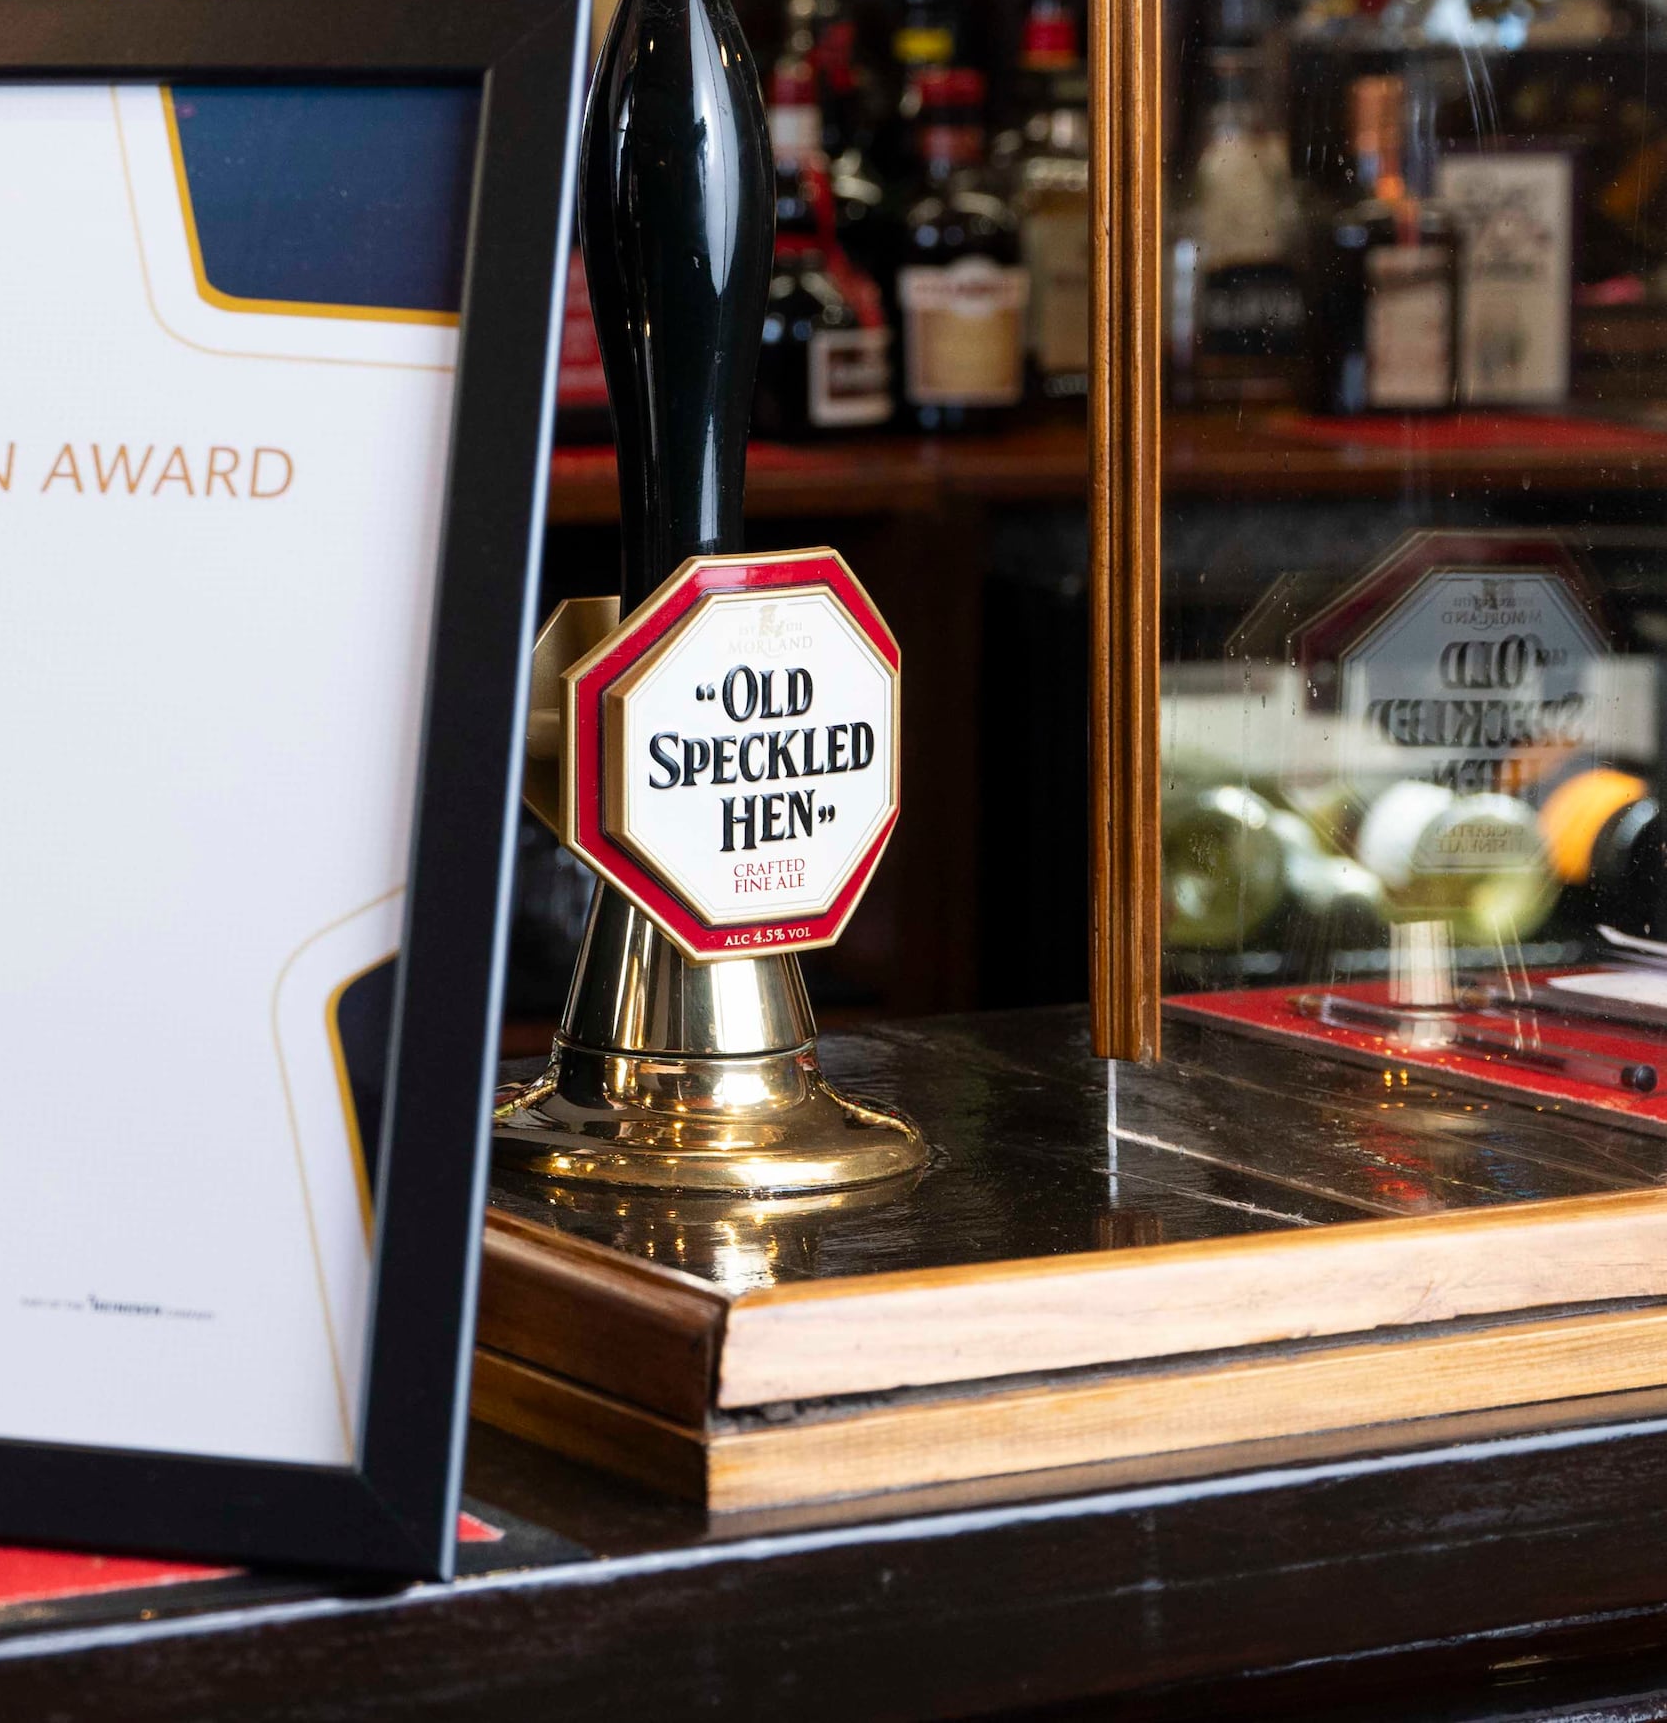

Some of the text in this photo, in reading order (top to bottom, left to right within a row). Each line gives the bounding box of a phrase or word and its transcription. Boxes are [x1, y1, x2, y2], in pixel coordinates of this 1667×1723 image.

[40, 441, 296, 499] AWARD
[727, 635, 814, 657] MORLAND
[648, 720, 876, 791] SPECKLED
[732, 858, 807, 879] CRAFTED
[733, 872, 807, 894] FINE ALE
[724, 925, 813, 947] ALC 4.5% VOL
